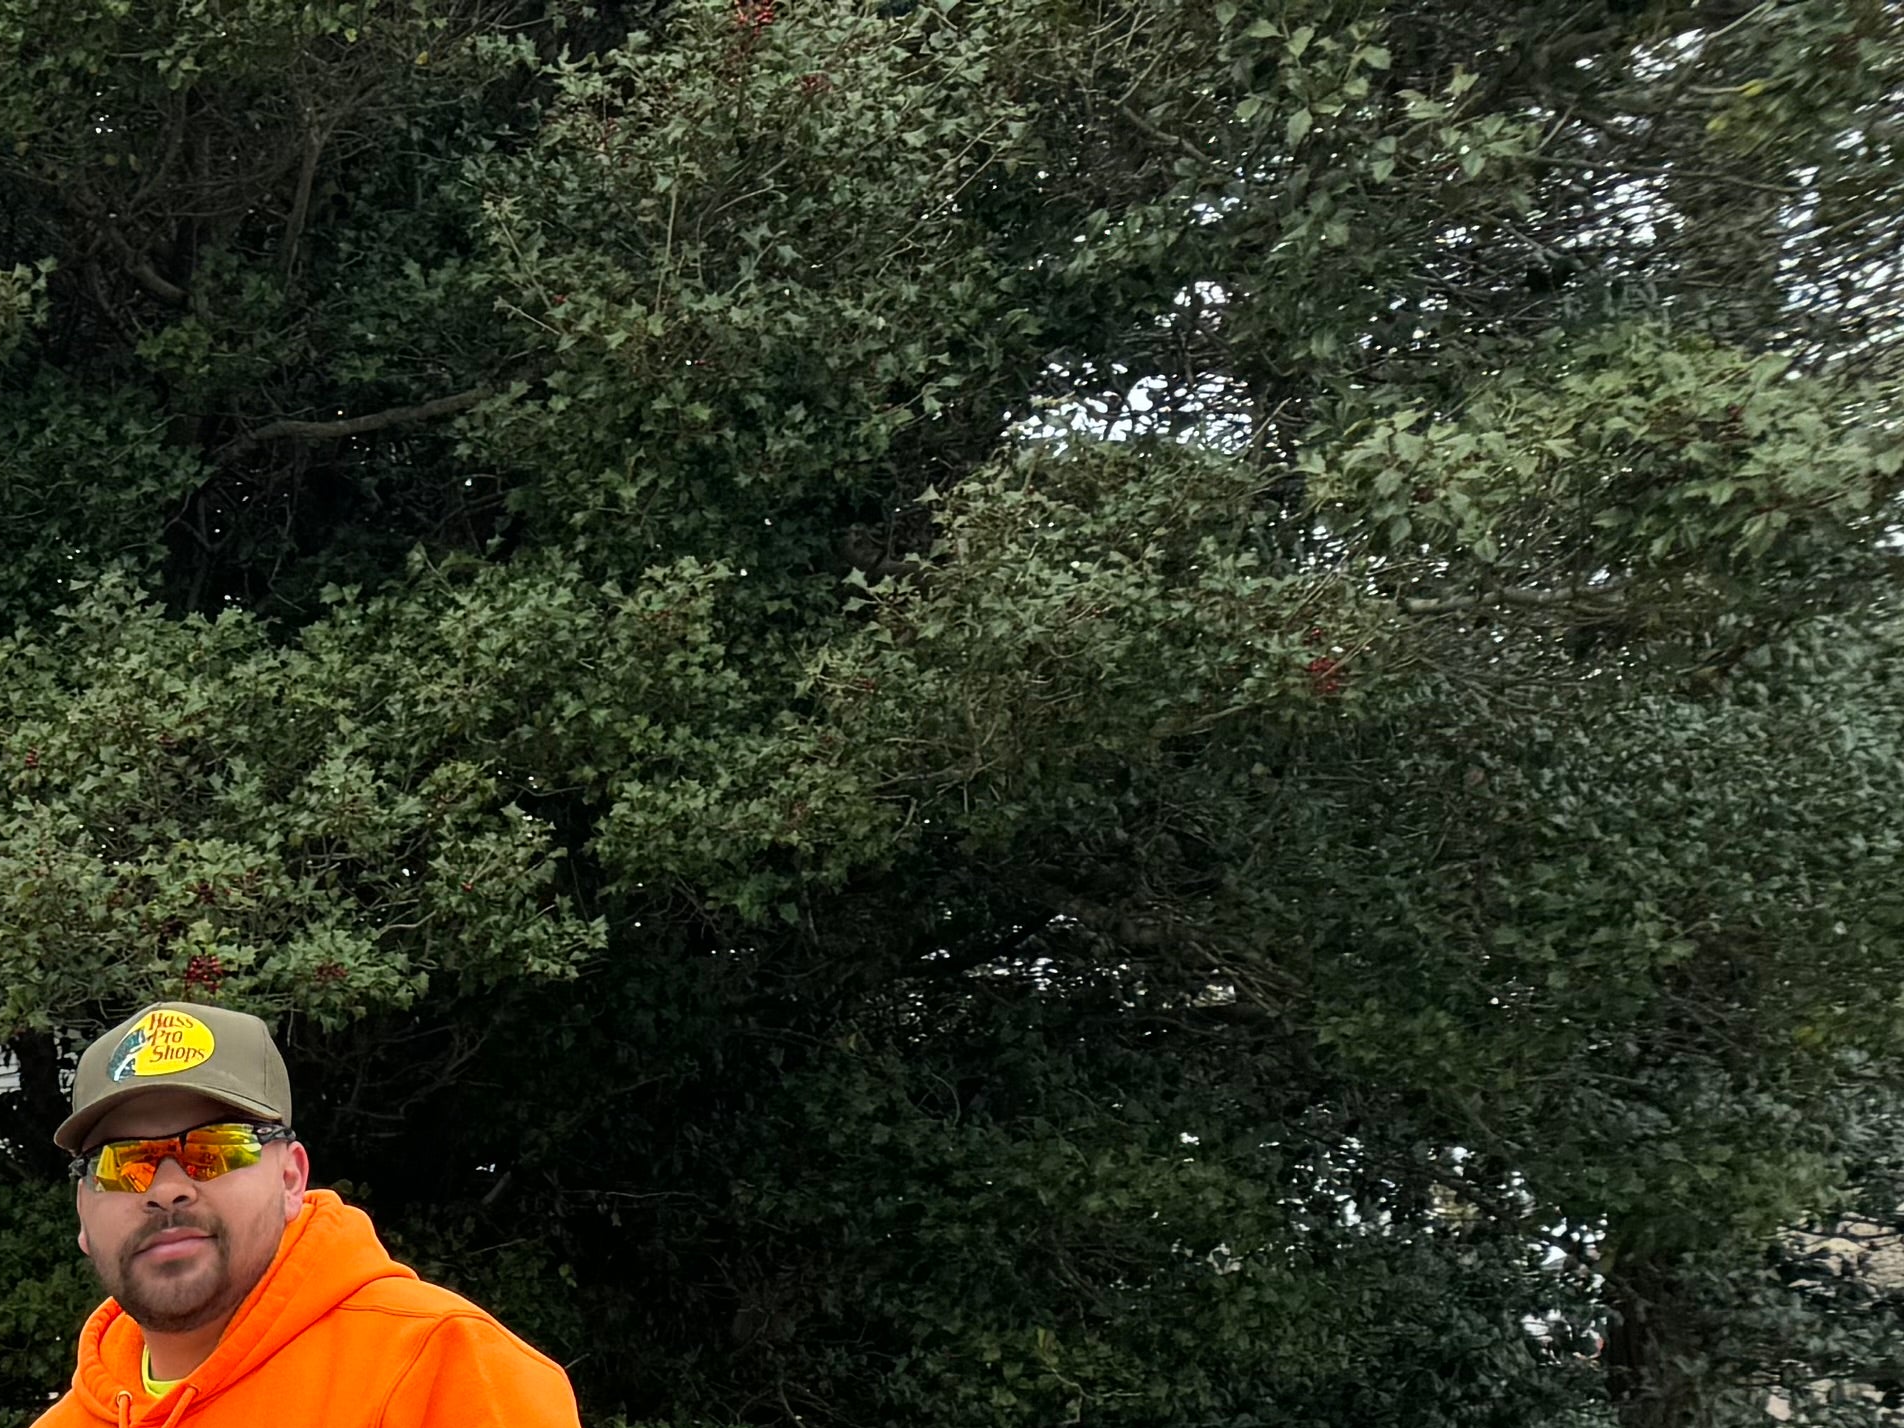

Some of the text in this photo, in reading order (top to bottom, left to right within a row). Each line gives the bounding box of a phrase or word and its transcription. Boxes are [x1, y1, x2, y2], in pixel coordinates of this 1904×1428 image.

[149, 1013, 193, 1030] Bass
[147, 1028, 183, 1046] Pro
[149, 1045, 204, 1062] Shops
